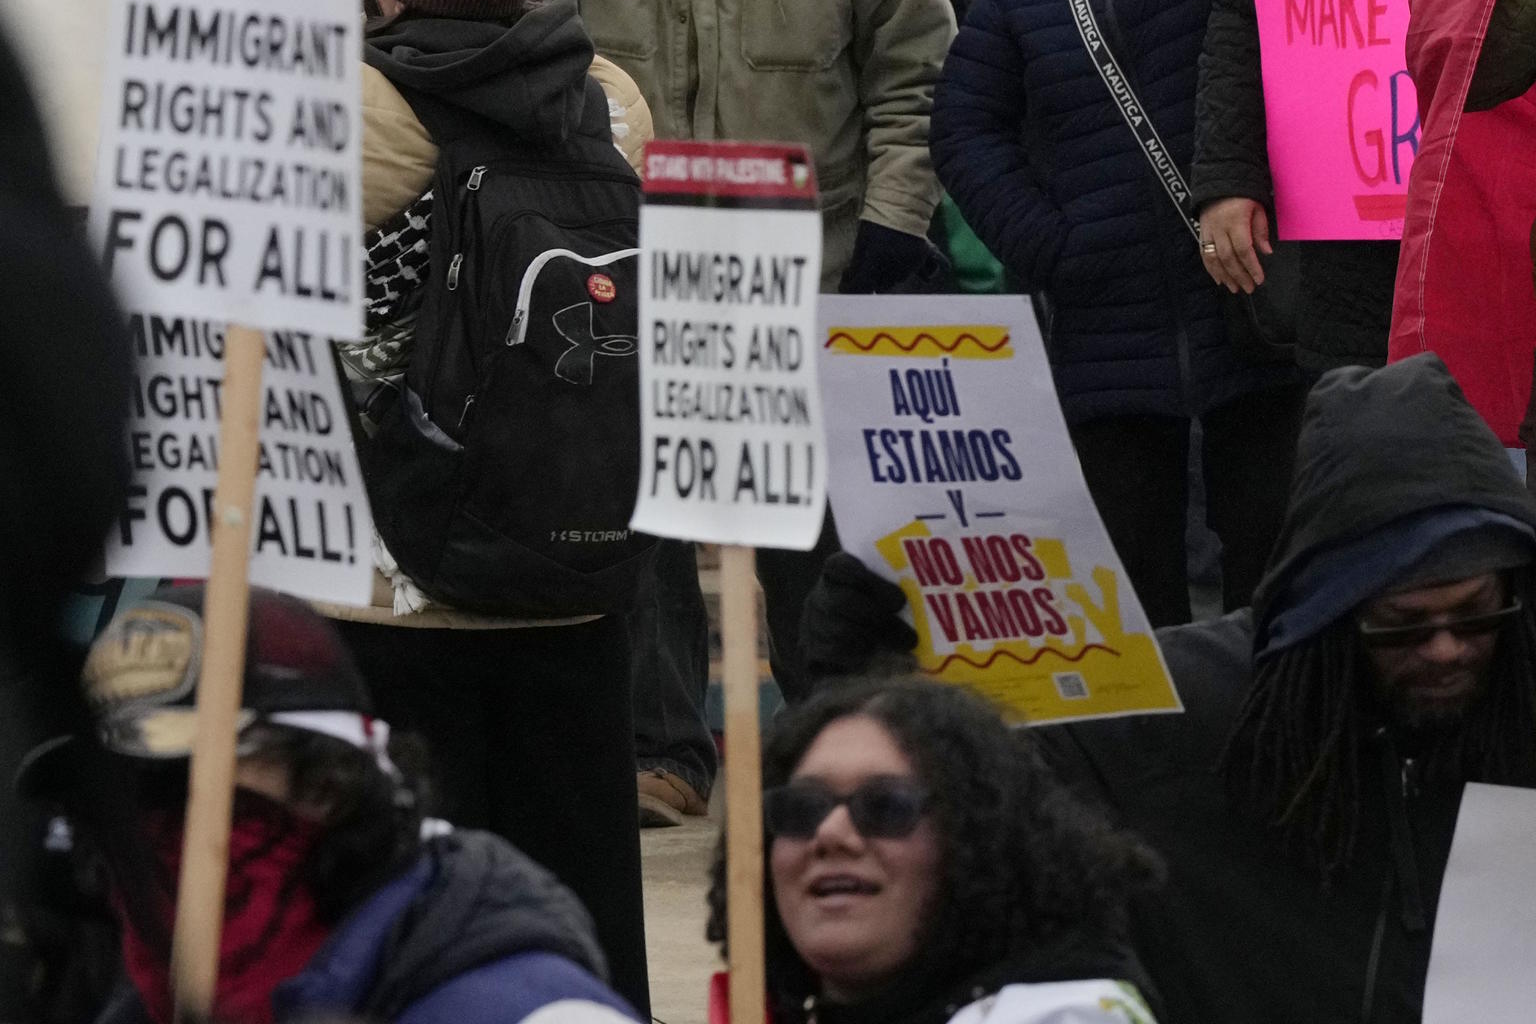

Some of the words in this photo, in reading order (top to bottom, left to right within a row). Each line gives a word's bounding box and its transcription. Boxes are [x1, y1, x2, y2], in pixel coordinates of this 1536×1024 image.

[124, 1, 347, 80] IMMIGRANT
[120, 78, 273, 143] RIGHTS
[287, 97, 350, 152] AND
[1102, 61, 1144, 127] NAUTICA
[116, 145, 348, 212] LEGALIZATION
[1145, 137, 1188, 204] NAUTICA
[102, 209, 231, 289] FOR
[254, 225, 351, 304] ALL!
[651, 250, 807, 307] IMMIGRANT
[652, 320, 736, 369] RIGHTS
[745, 327, 802, 372] AND
[264, 386, 332, 436] AND
[653, 378, 810, 426] LEGALIZATION
[889, 358, 961, 424] AQUÍ
[651, 436, 717, 501] FOR
[733, 440, 814, 507] ALL!
[862, 428, 1024, 484] ESTAMOS
[255, 494, 357, 565] ALL!
[568, 529, 629, 543] STORM
[903, 537, 962, 588] NO
[961, 533, 1045, 586] NOS
[926, 587, 1069, 643] VAMOS
